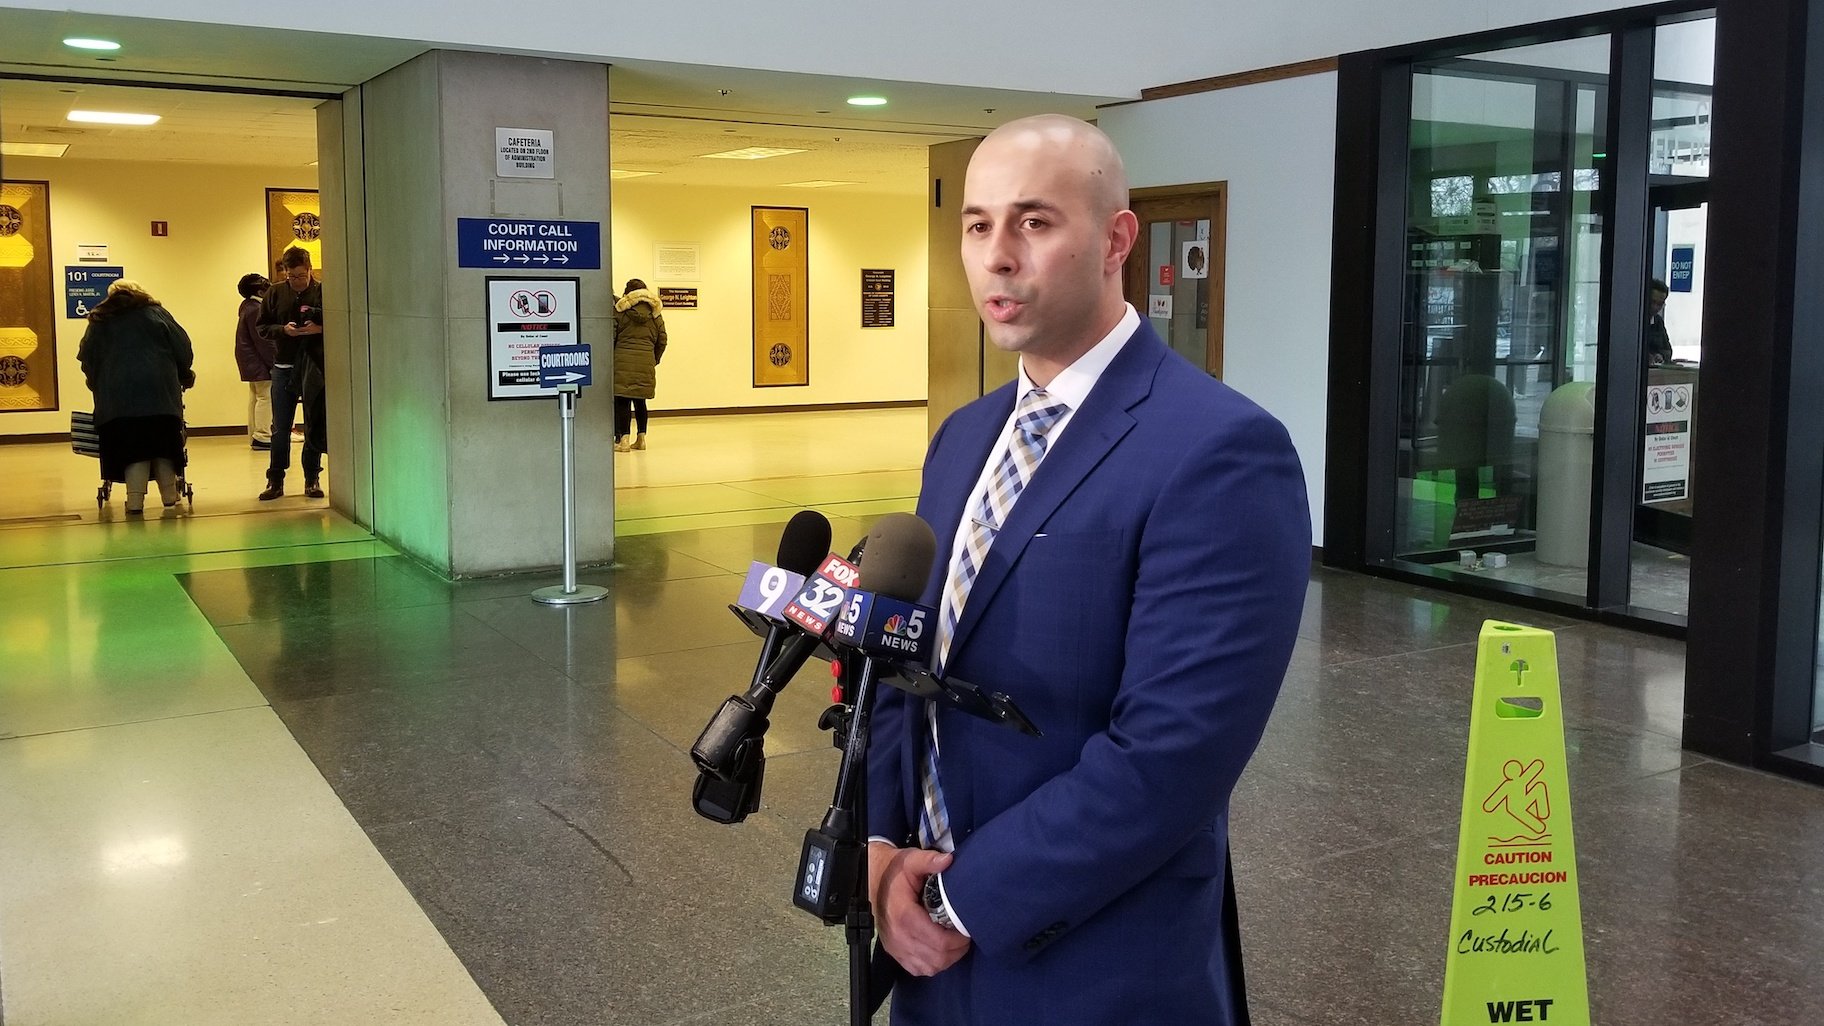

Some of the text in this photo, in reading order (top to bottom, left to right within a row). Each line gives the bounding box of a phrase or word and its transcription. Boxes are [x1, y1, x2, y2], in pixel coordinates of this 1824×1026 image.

[508, 138, 541, 147] CAFETERIA
[488, 223, 573, 237] COURT CALL
[483, 239, 578, 252] INFORMATION
[1672, 261, 1692, 270] DO NOT
[67, 271, 88, 282] 101
[541, 351, 590, 368] COURTROOMS
[823, 558, 859, 587] FOX
[756, 567, 788, 612] 9
[799, 577, 844, 618] 32
[788, 605, 823, 631] NEWS
[848, 594, 864, 624] 5
[906, 609, 926, 639] 5
[880, 634, 918, 653] NEWS
[1484, 851, 1553, 865] CAUTION
[1469, 871, 1567, 887] PRECAUCION
[1472, 892, 1552, 916] 215-6
[1487, 999, 1554, 1024] WET
